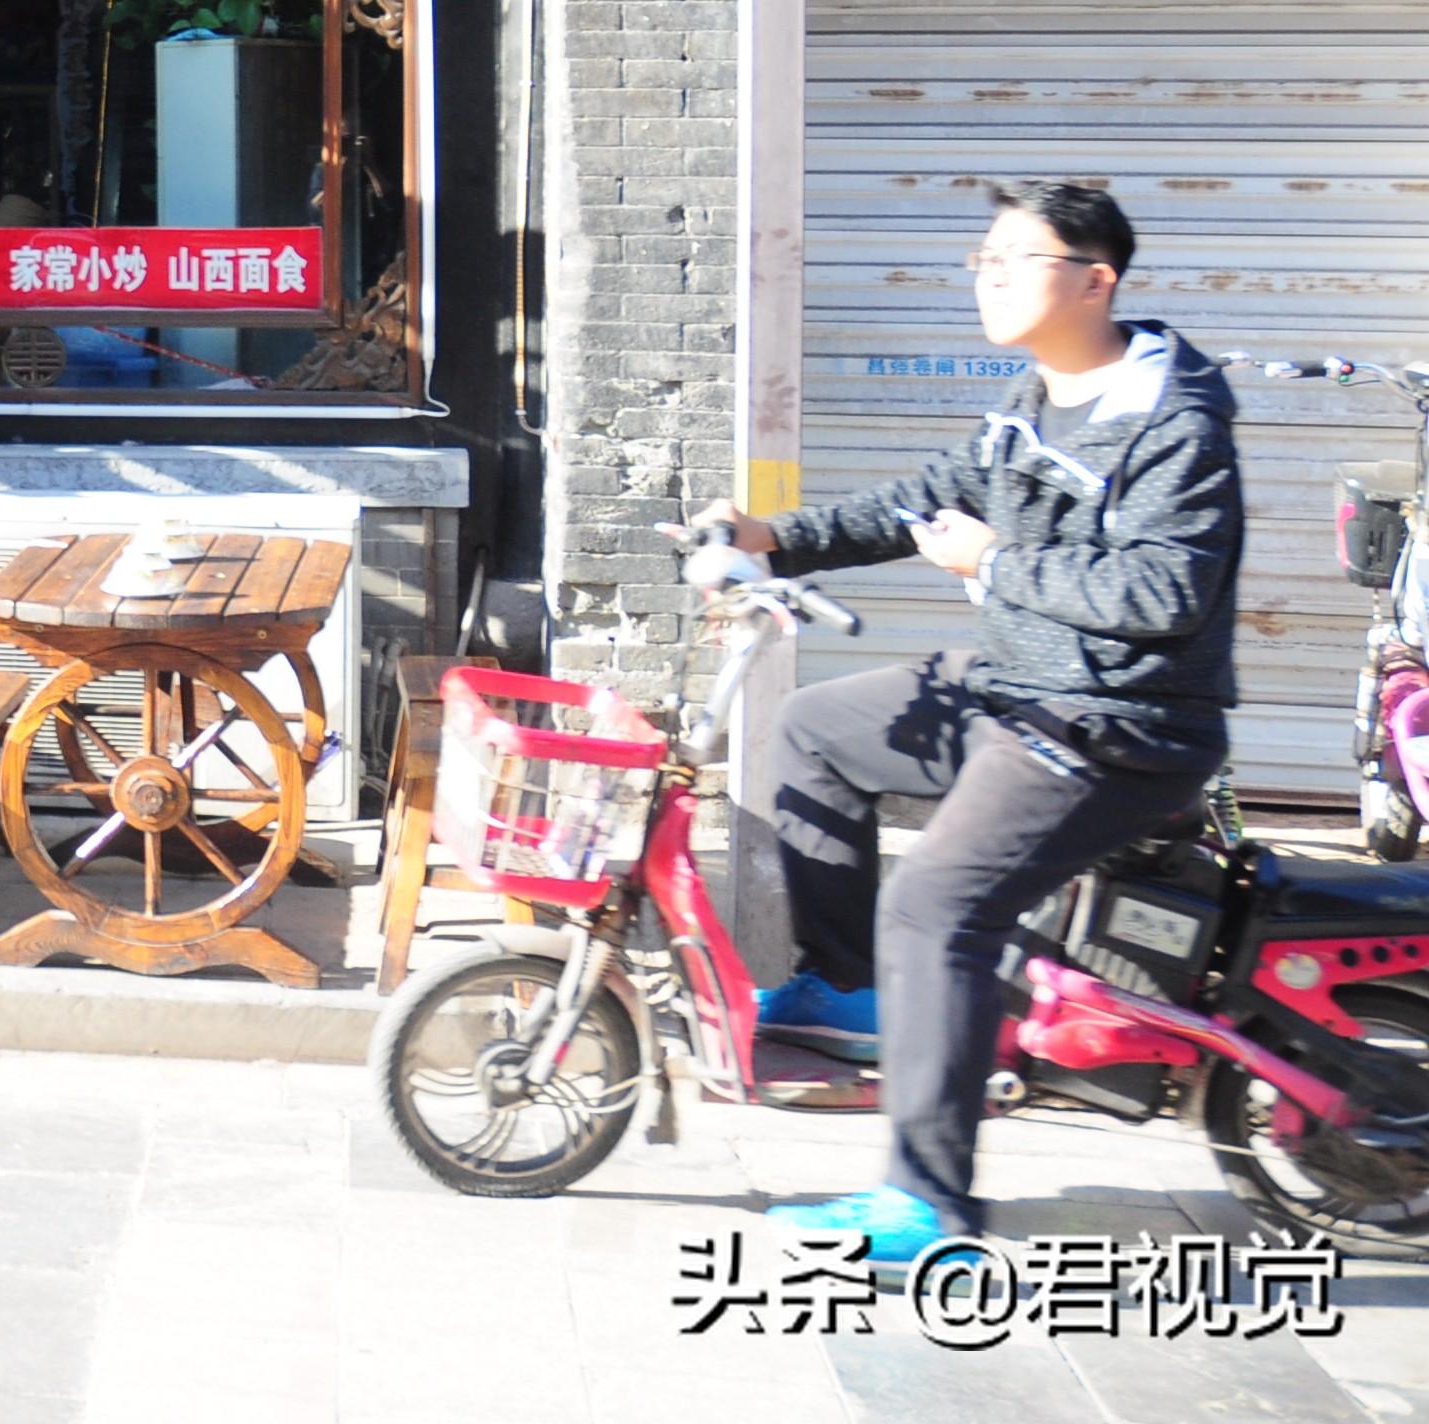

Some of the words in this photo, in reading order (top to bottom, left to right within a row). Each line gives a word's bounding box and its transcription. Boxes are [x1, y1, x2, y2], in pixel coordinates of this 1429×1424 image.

[8, 246, 147, 294] 家常小炒
[167, 245, 309, 294] 山西面食
